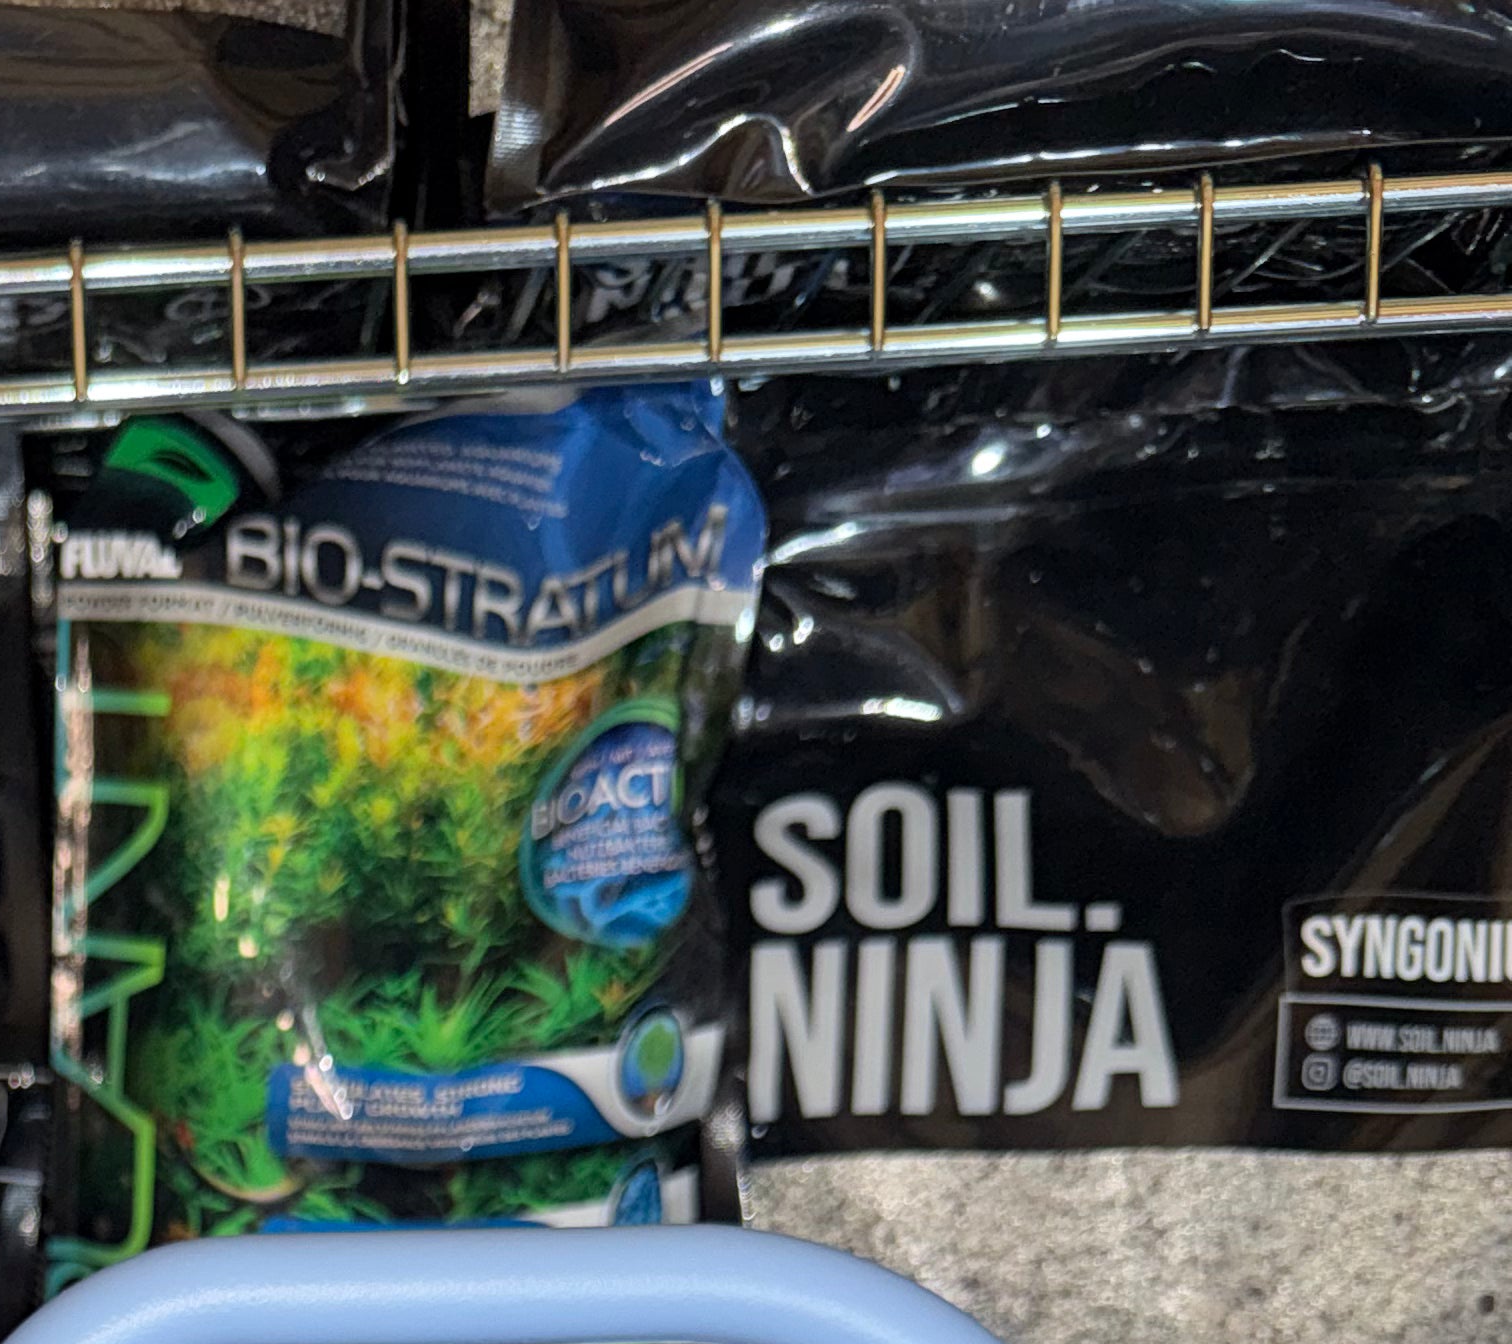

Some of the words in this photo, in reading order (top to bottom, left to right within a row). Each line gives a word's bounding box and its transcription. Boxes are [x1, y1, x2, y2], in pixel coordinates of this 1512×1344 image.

[225, 503, 728, 646] BIO-STRATUM
[749, 781, 1122, 934] SOIL.
[748, 935, 1180, 1123] NINJA
